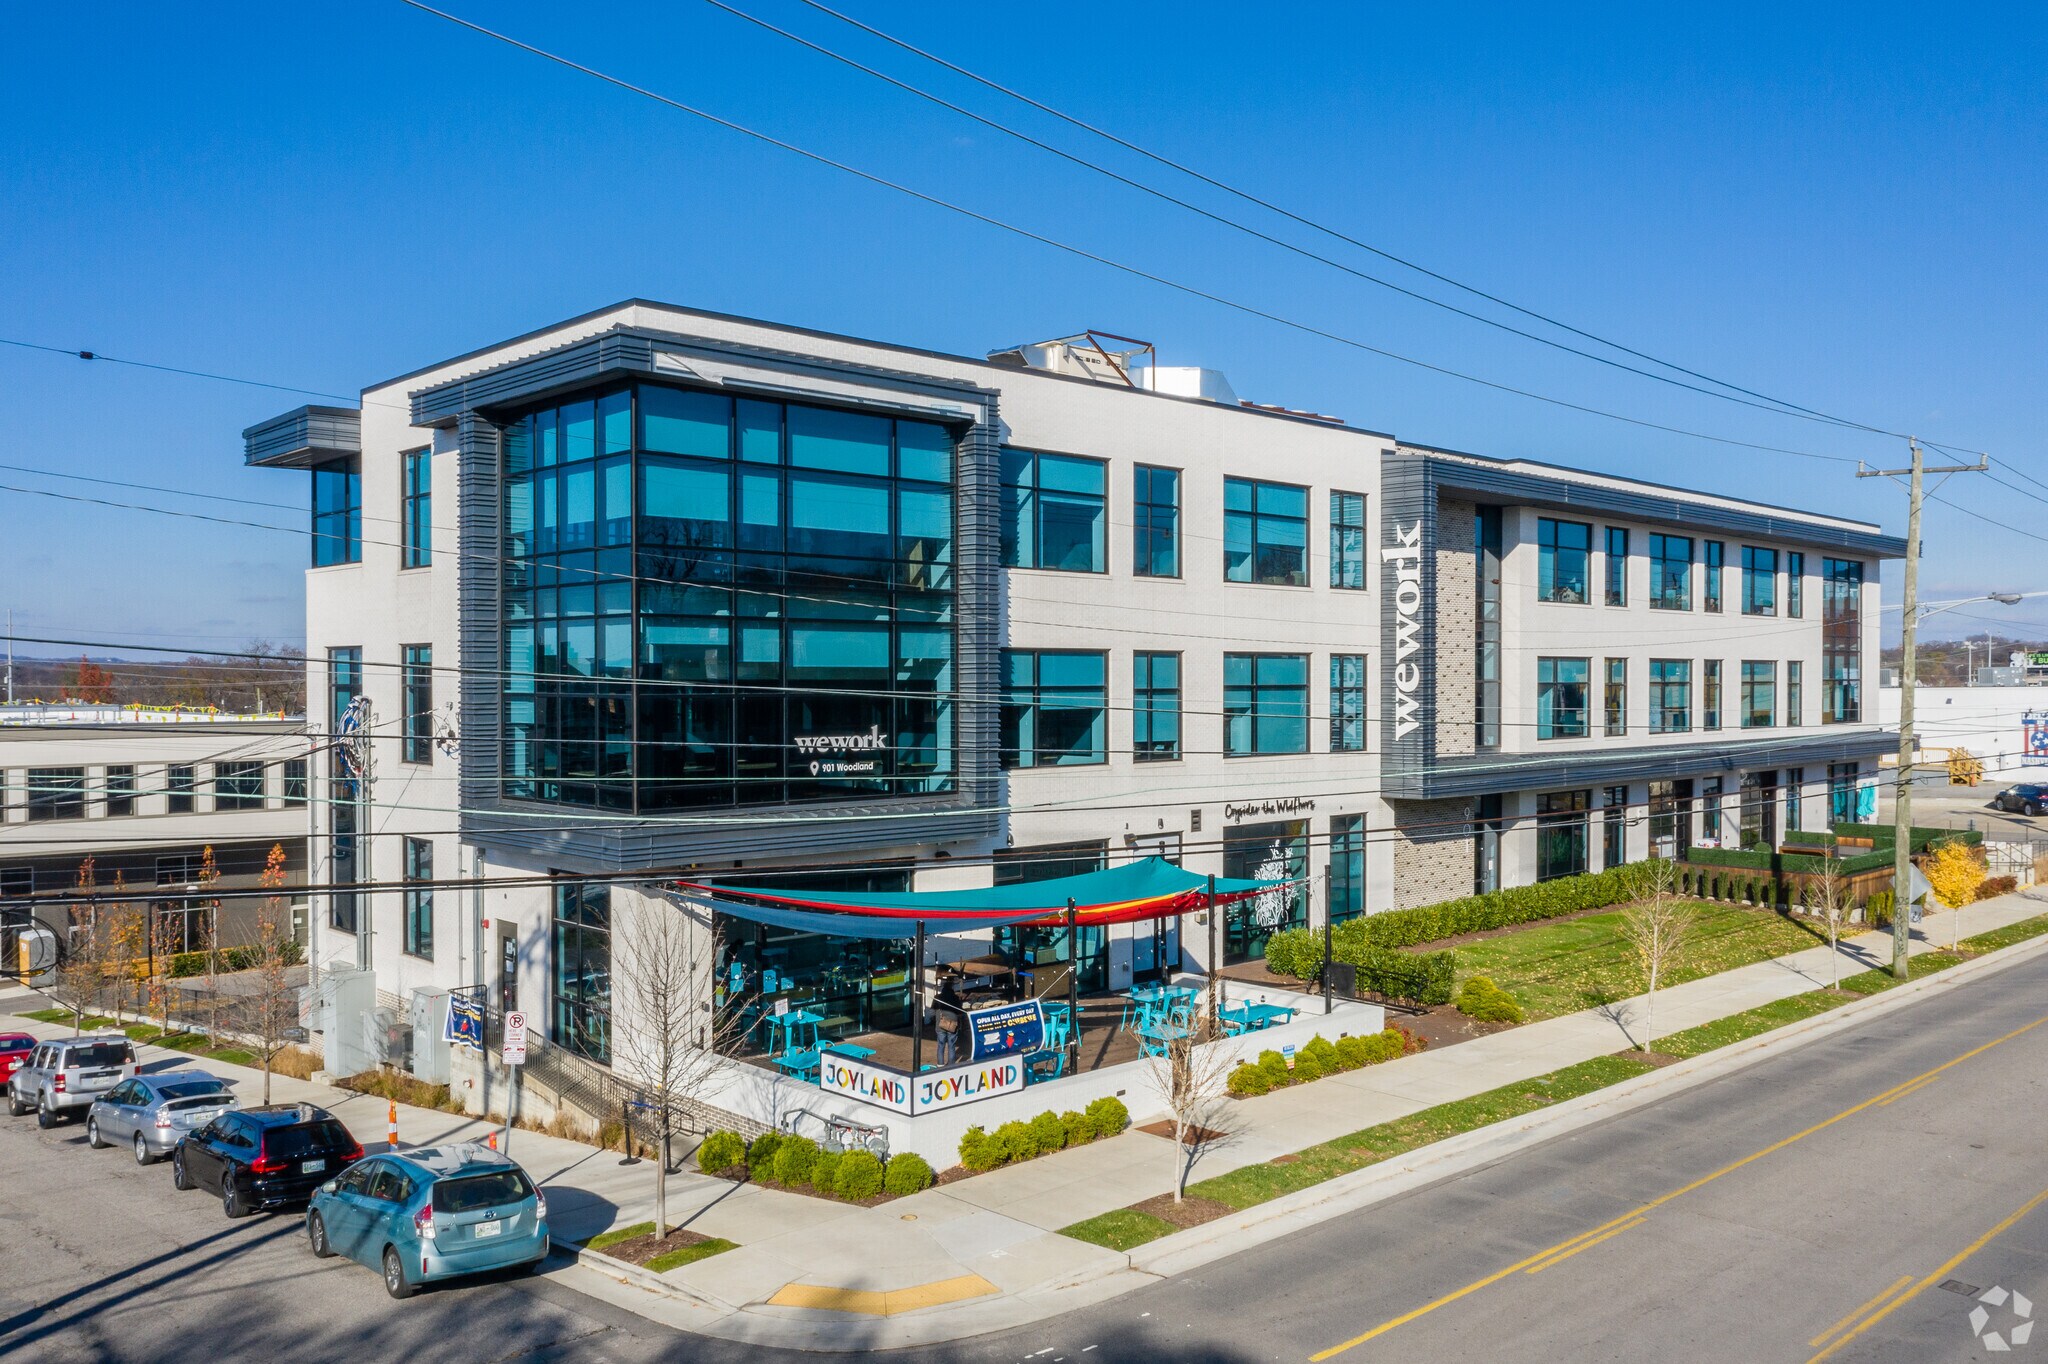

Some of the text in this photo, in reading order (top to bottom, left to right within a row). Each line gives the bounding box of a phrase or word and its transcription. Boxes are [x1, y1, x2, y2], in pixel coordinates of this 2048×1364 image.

[1381, 519, 1421, 742] wework
[794, 724, 887, 754] wework
[822, 762, 874, 772] 901 Woodland
[1262, 801, 1276, 814] the
[976, 1016, 991, 1025] OPEN
[991, 1014, 1001, 1023] ALL
[1011, 1010, 1026, 1018] EVERY
[1026, 1007, 1035, 1015] DAY
[825, 1063, 906, 1105] JOYLAND
[920, 1064, 1018, 1105] JOYLAND
